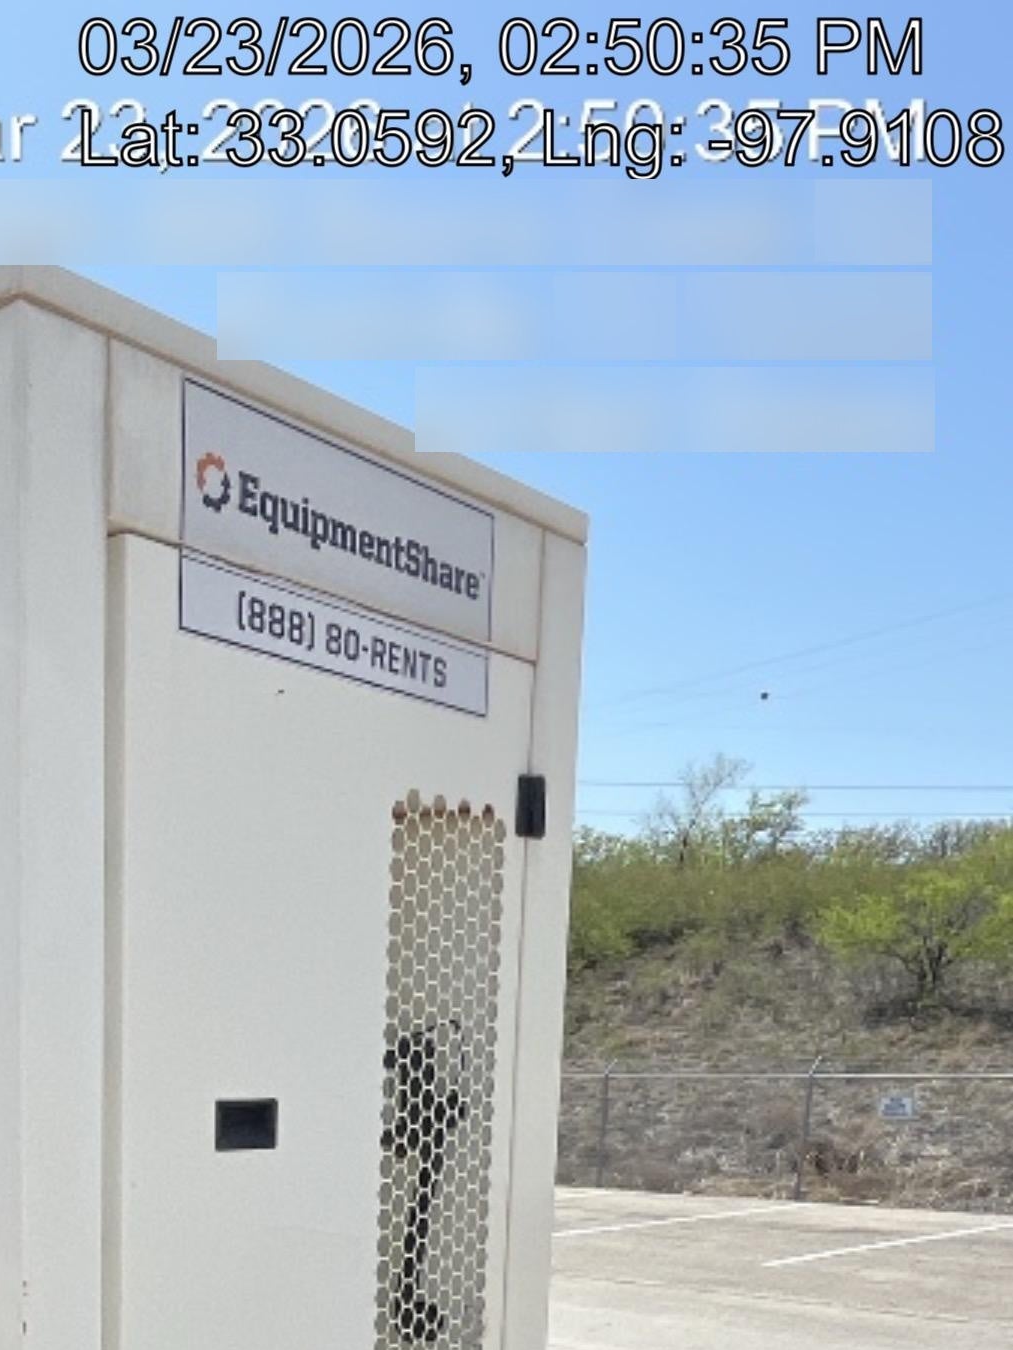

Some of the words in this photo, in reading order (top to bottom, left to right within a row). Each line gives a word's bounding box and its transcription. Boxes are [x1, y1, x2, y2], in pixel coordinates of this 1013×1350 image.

[237, 469, 481, 600] EquipmentShare
[238, 591, 315, 652] (888)
[325, 623, 447, 689] 80-RENTS
